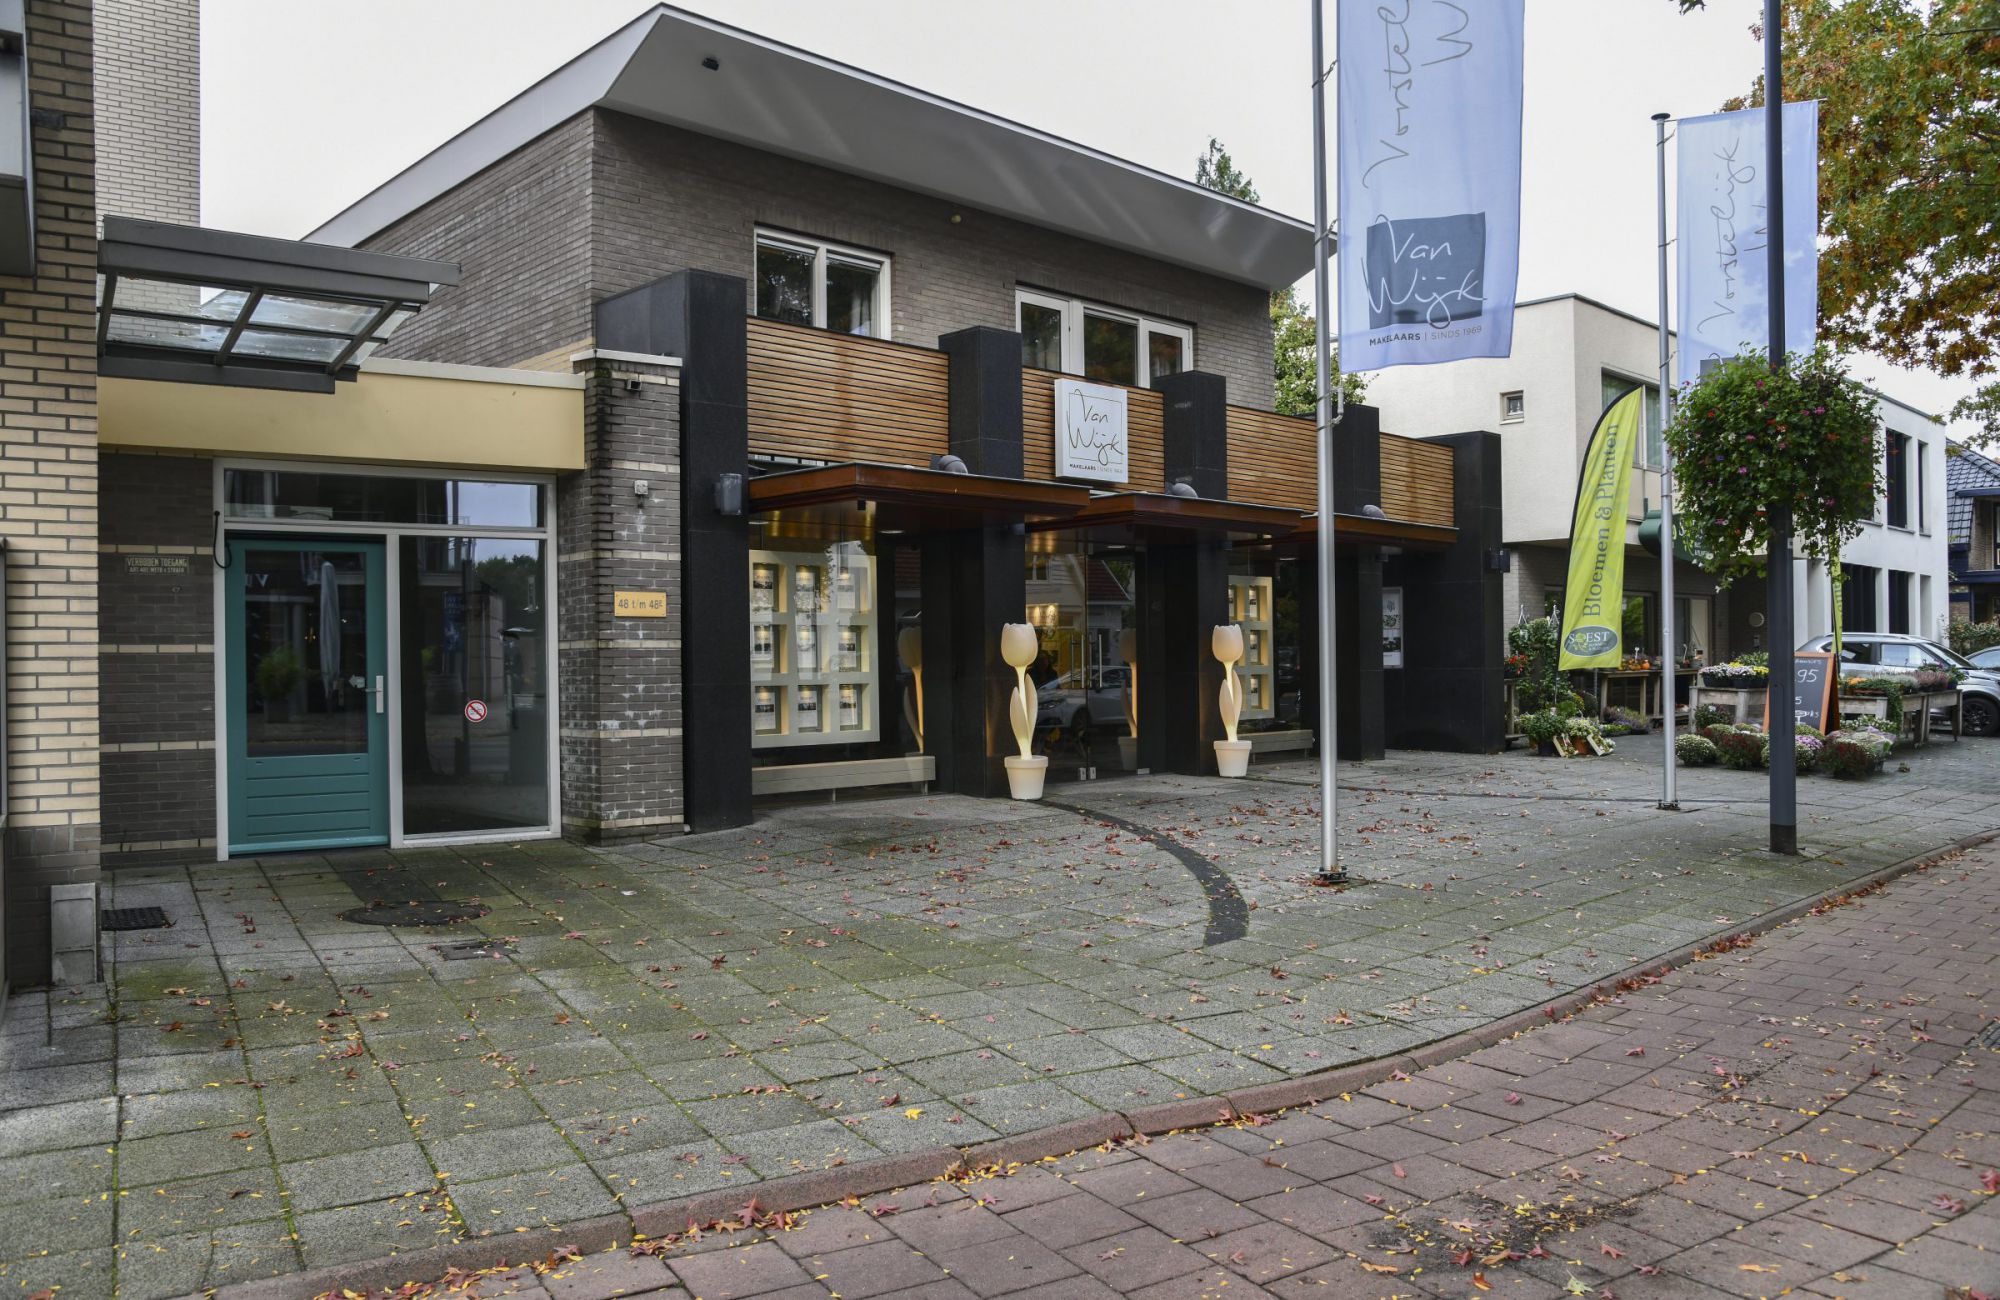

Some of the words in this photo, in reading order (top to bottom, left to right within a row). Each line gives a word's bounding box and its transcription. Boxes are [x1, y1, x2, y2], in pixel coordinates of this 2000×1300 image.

[1362, 0, 1413, 189] Vorstel
[1375, 213, 1452, 264] Van
[1697, 137, 1756, 334] Vorstelijk
[1361, 257, 1488, 330] Wijk
[1369, 333, 1421, 347] MAKELAARS
[1431, 329, 1460, 341] SINDS
[1463, 326, 1482, 337] 1969
[1073, 388, 1109, 423] Van
[1066, 410, 1125, 467] Wijk
[1596, 423, 1619, 501] Planten
[1594, 506, 1613, 521] &
[1582, 527, 1611, 618] Bloemen
[618, 599, 629, 609] 48
[632, 599, 647, 609] t/m
